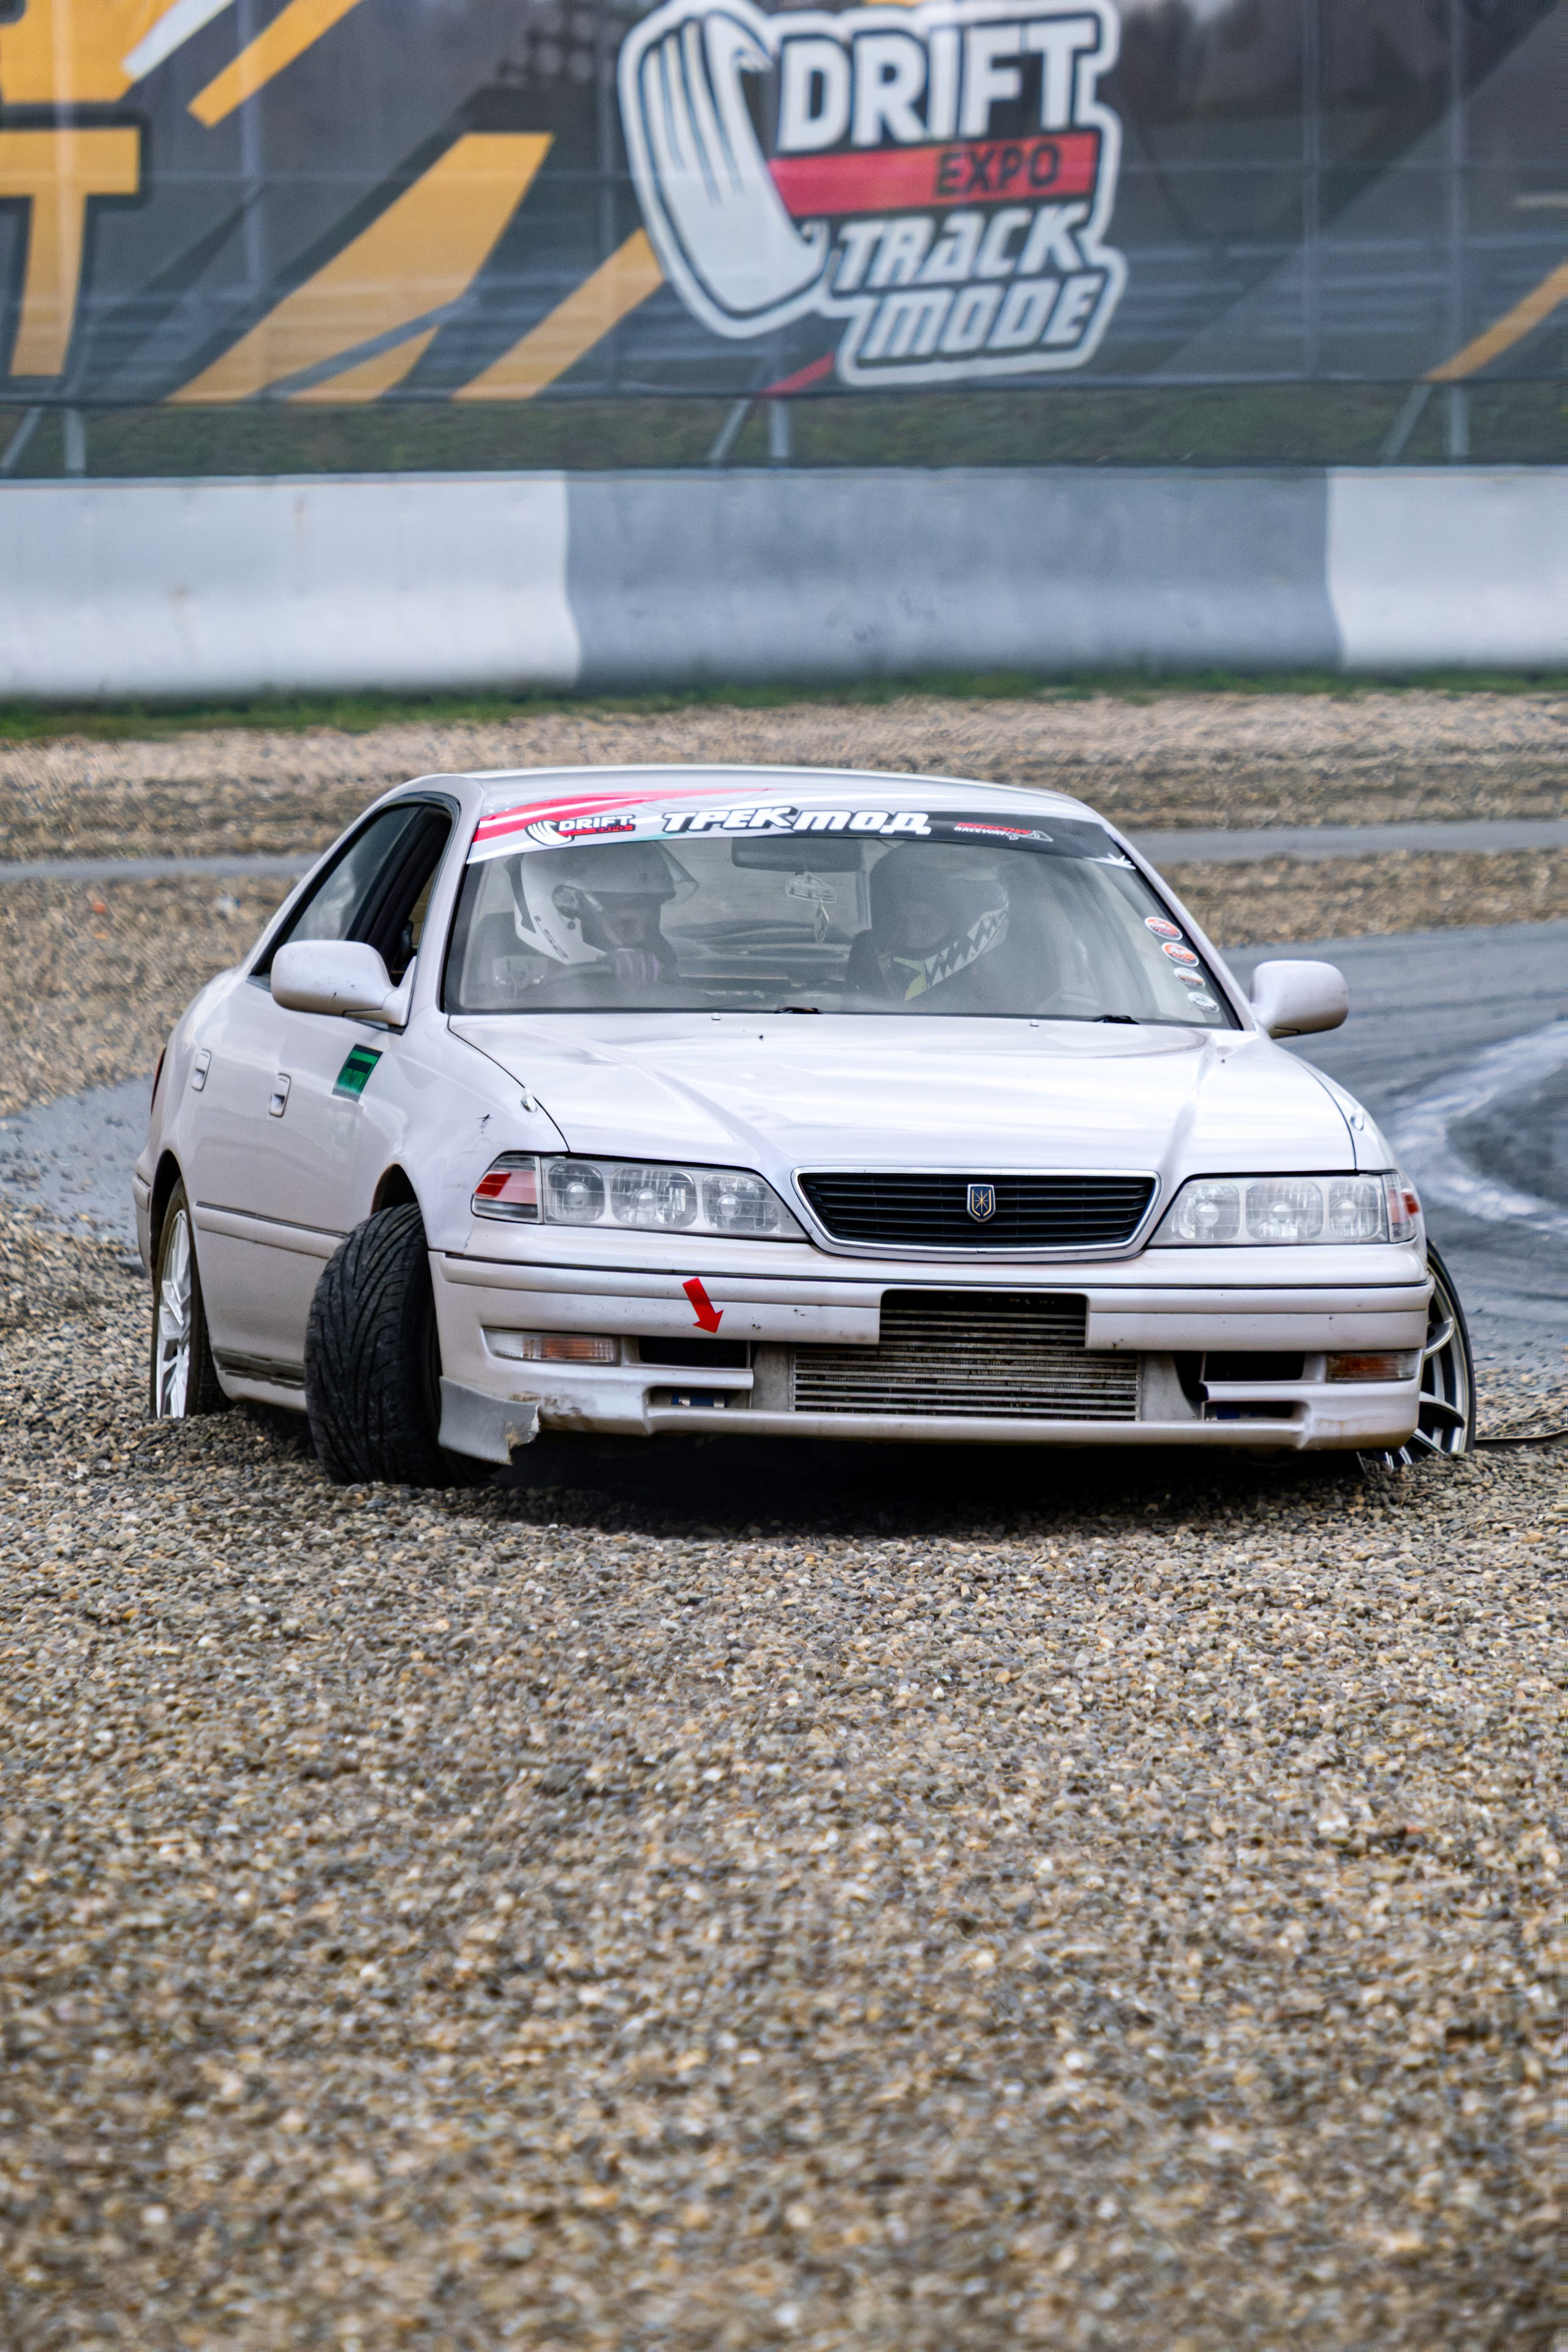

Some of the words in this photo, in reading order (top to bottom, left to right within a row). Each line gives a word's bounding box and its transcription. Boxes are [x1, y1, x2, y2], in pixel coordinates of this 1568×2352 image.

[779, 18, 1095, 151] DRIFT
[936, 141, 1062, 194] EXPO
[834, 203, 1090, 290] TRACK
[861, 277, 1101, 358] MODE
[559, 815, 633, 832] DRIFT
